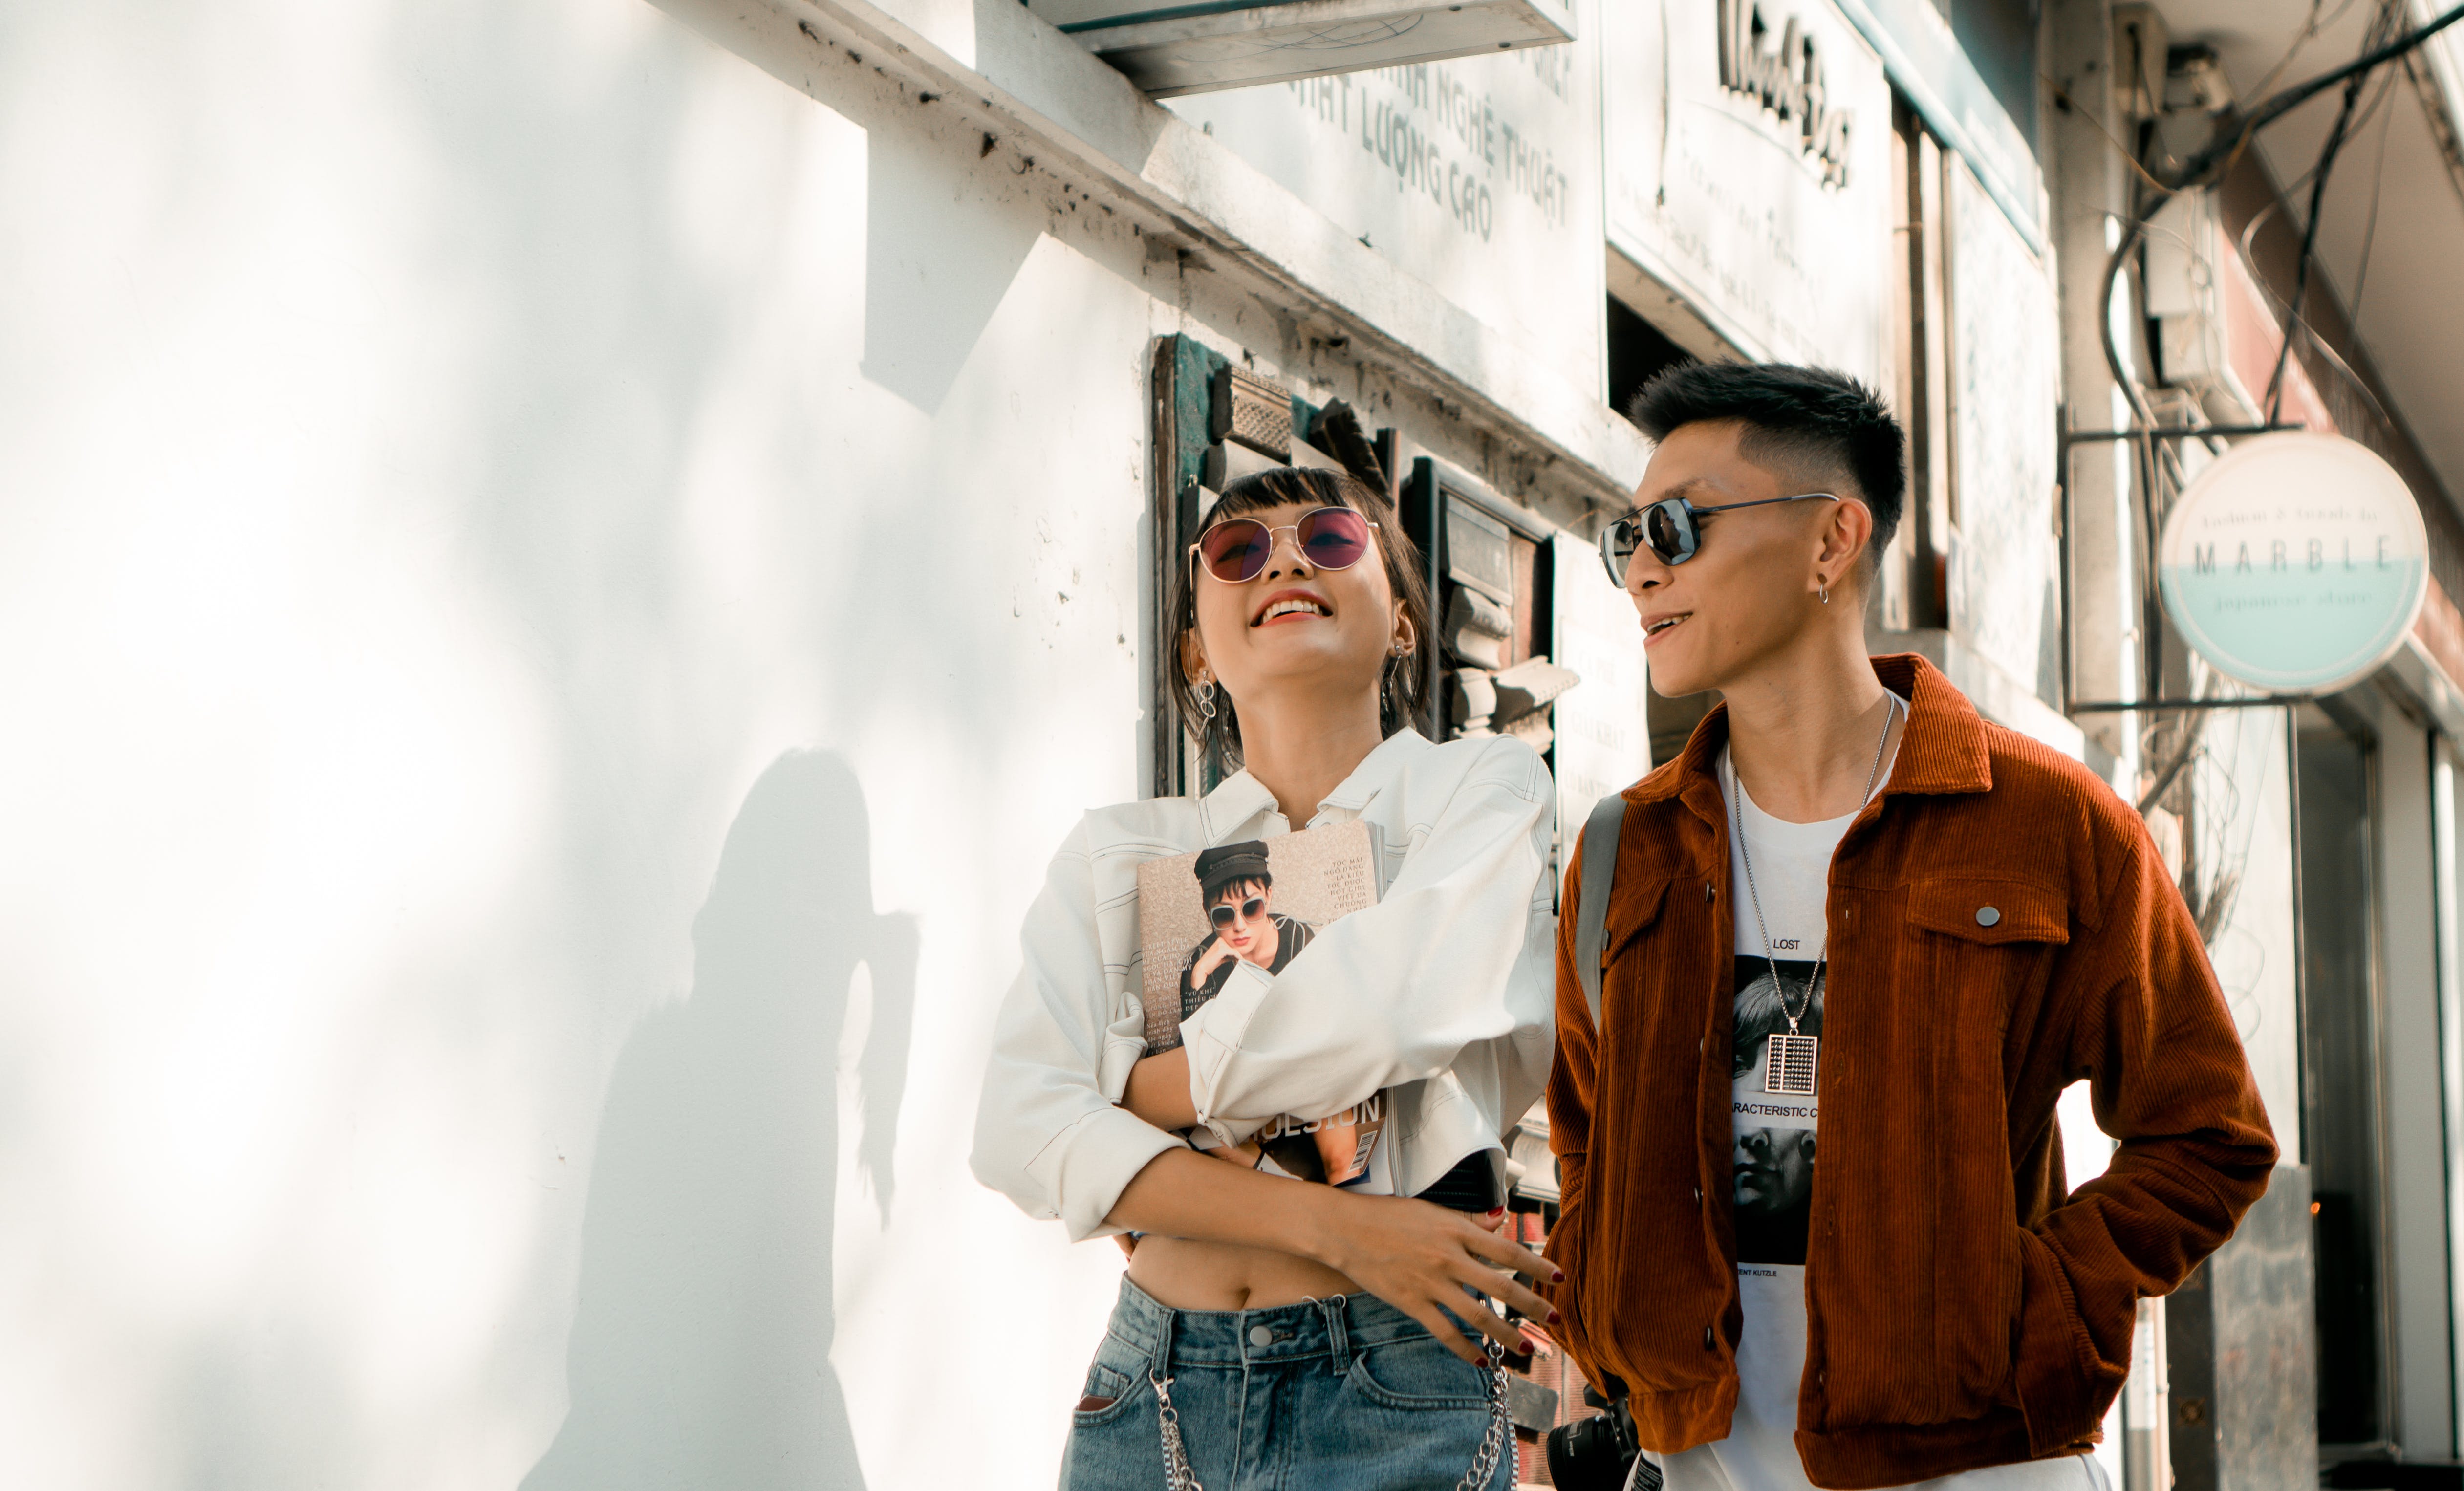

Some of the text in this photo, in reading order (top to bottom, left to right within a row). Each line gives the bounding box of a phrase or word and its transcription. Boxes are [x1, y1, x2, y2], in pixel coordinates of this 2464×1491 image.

[1450, 160, 1492, 244] CAO
[2195, 534, 2391, 575] MARBLE
[1773, 939, 1801, 950] LOST
